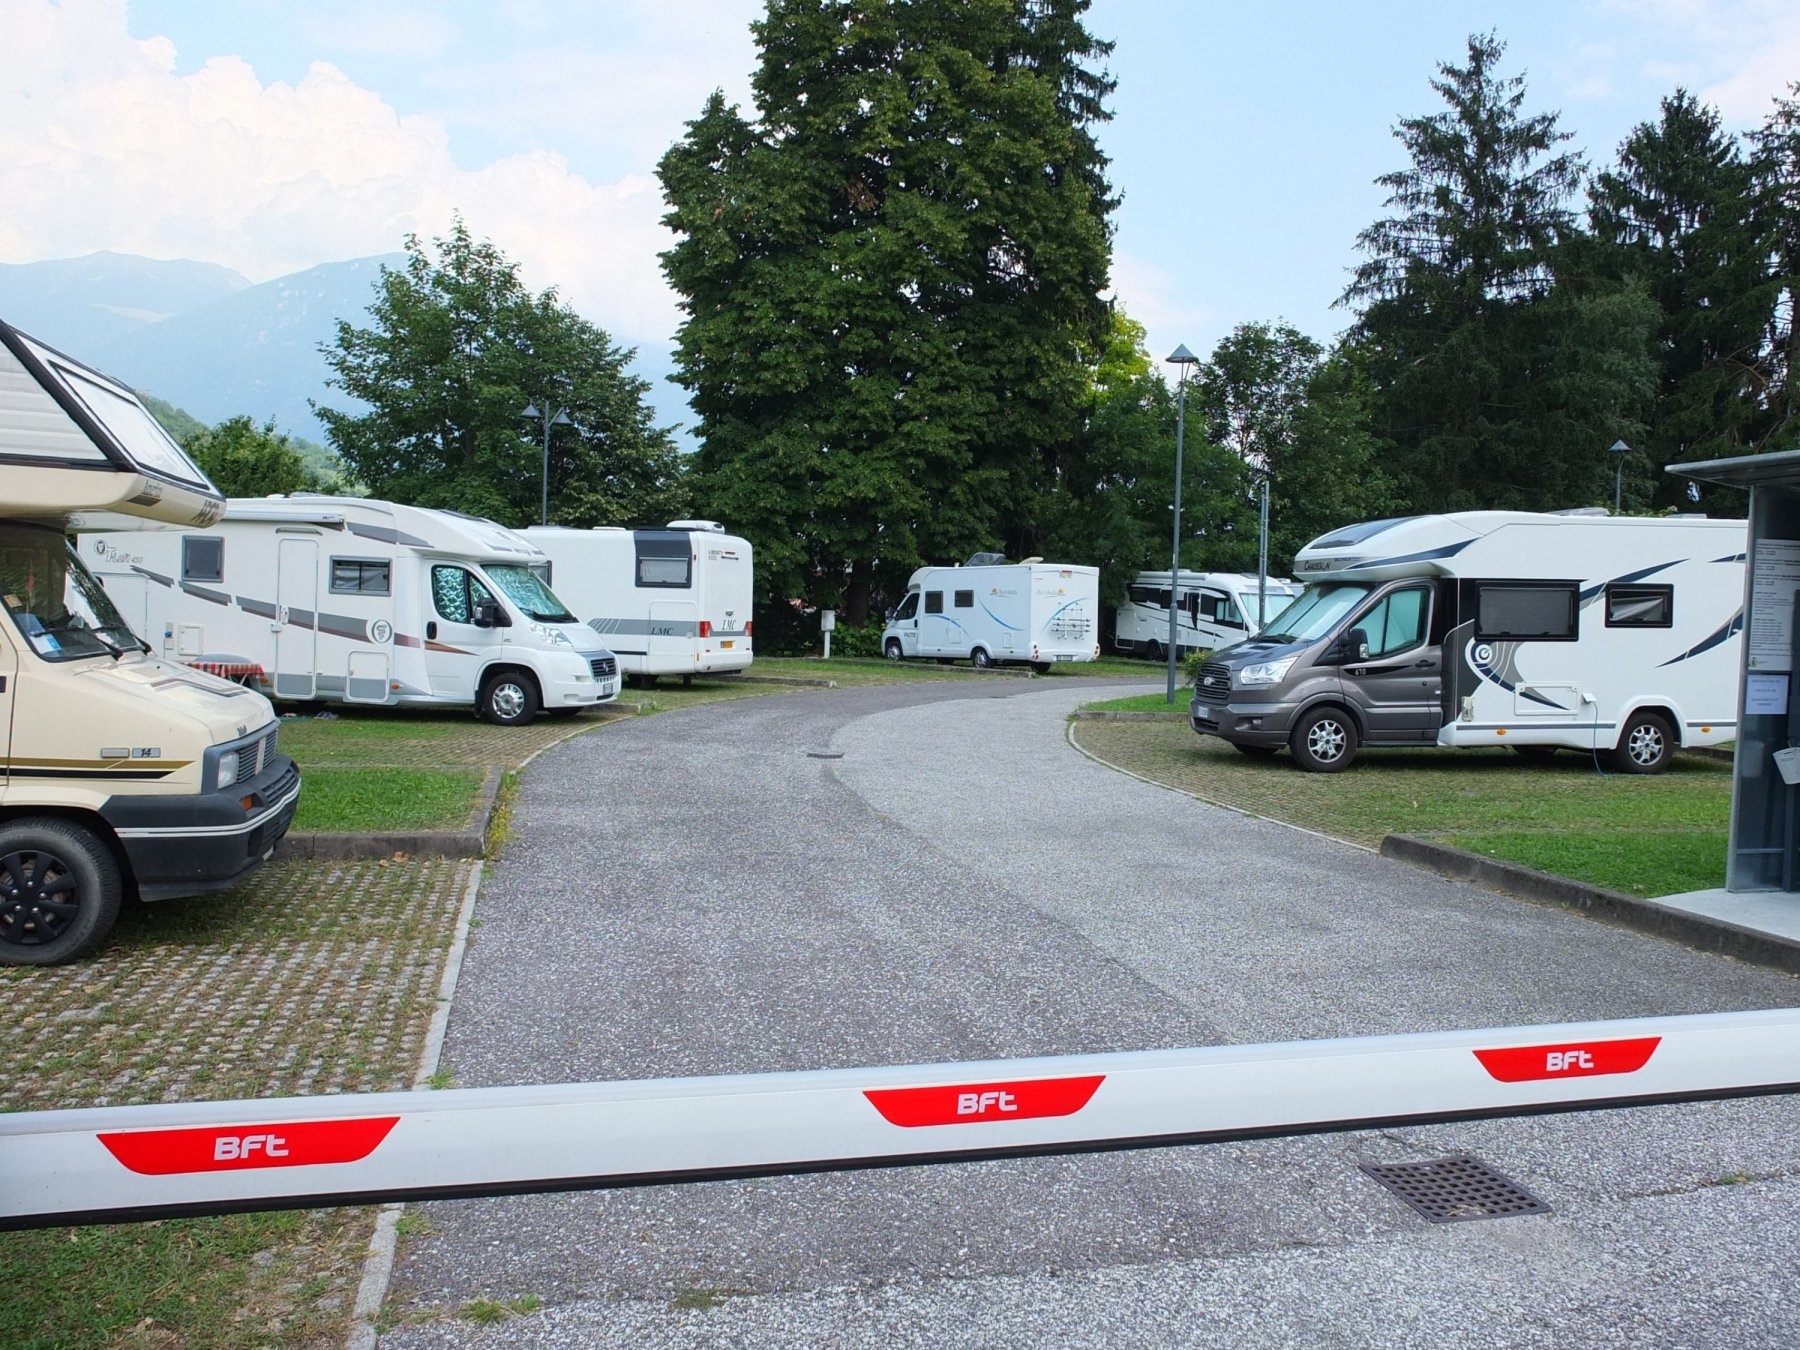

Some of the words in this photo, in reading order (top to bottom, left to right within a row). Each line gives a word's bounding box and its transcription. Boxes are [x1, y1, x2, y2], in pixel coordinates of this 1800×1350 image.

[722, 619, 737, 631] LMC
[651, 627, 674, 636] LMC
[141, 748, 152, 757] 14
